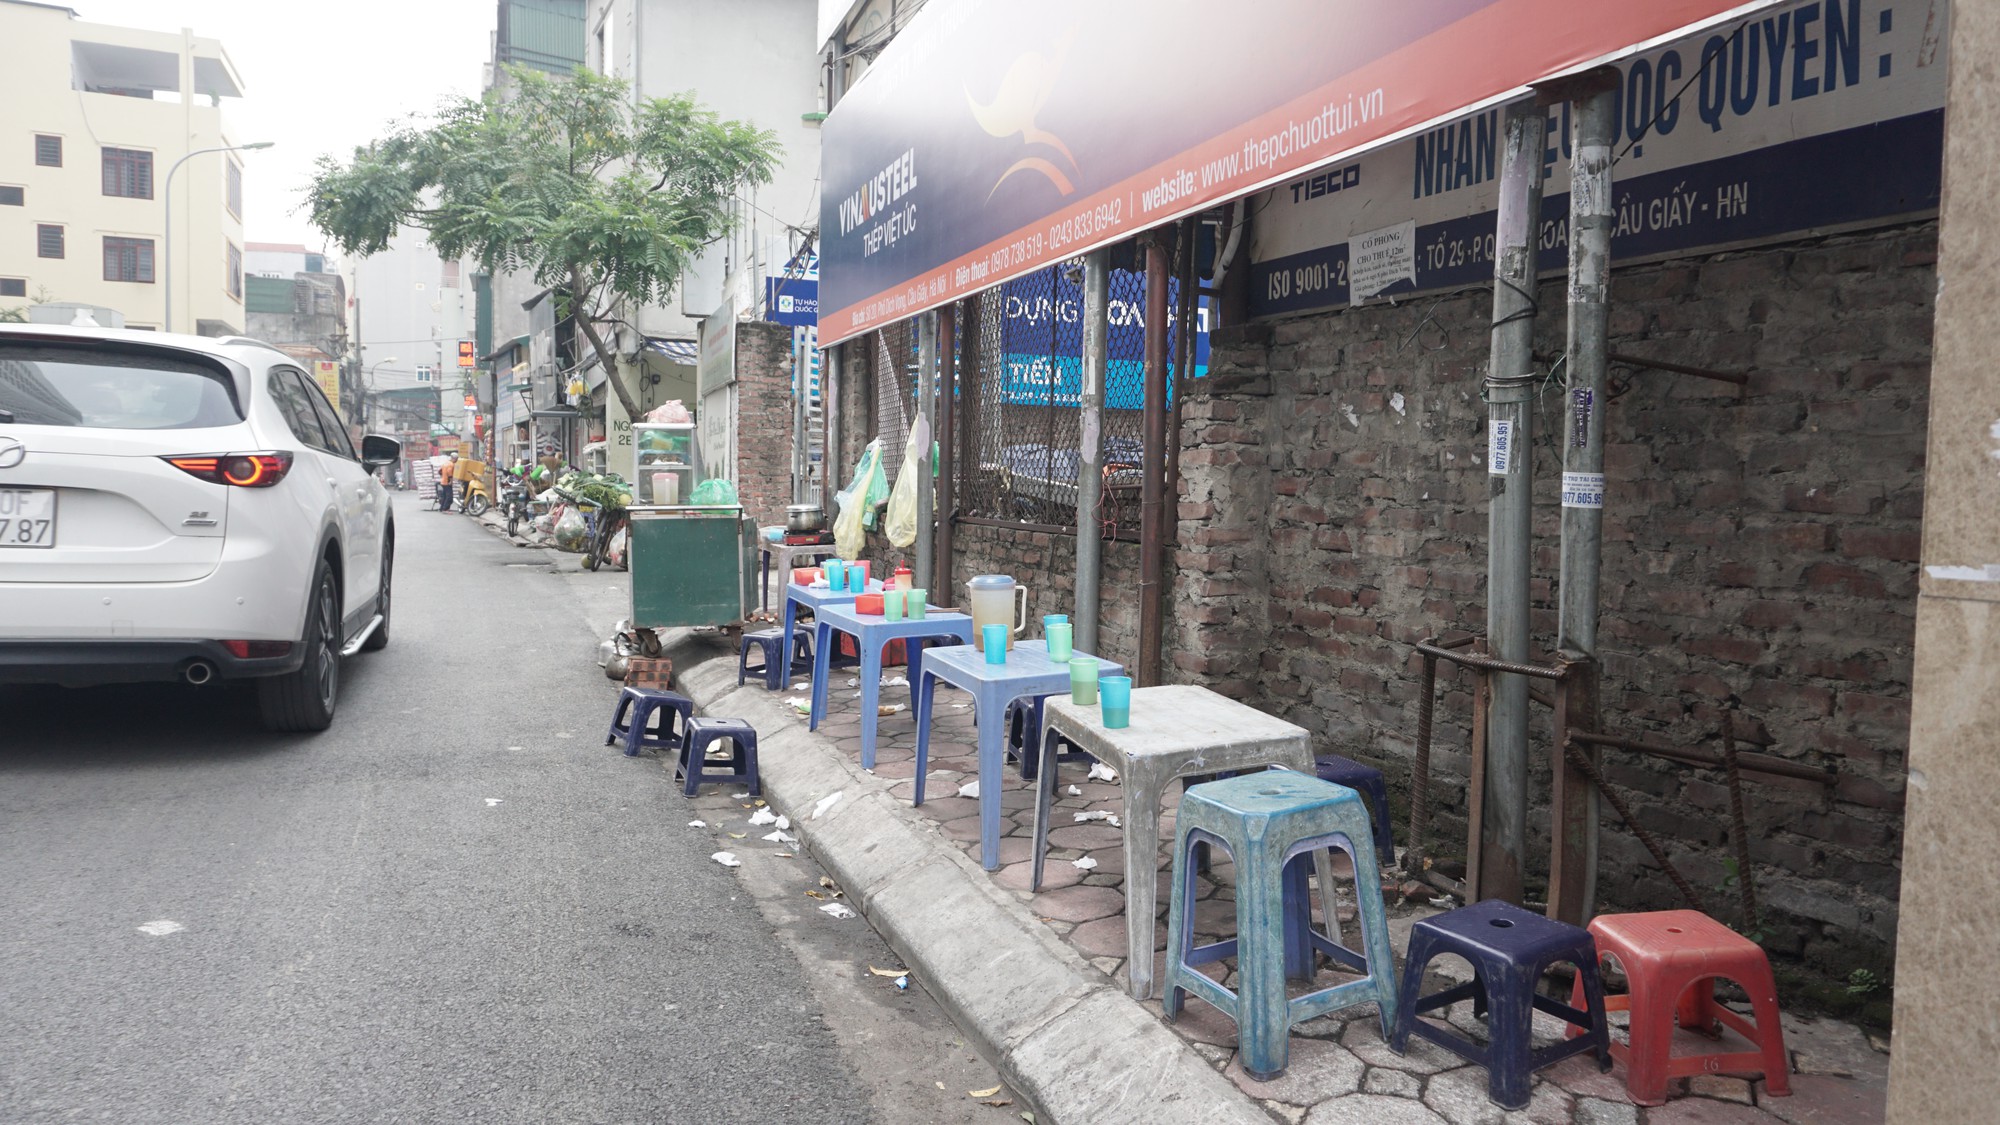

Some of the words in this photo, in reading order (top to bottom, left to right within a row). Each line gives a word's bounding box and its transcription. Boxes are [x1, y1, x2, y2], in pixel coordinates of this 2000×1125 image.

[1142, 168, 1198, 213] website:
[1201, 87, 1384, 202] www.thepchuottui.vn
[1290, 163, 1361, 204] TISCO
[863, 221, 883, 258] THÉP
[882, 211, 902, 248] VIỆT
[902, 201, 917, 236] ÚC
[955, 266, 970, 290] Điện
[971, 256, 989, 281] thoại:
[991, 247, 1009, 273] 0978
[1010, 242, 1026, 268] 738
[1026, 232, 1042, 260] 519
[1049, 220, 1072, 250] 0243
[1074, 210, 1093, 241] 833
[1094, 198, 1122, 232] 6942
[1268, 269, 1290, 301] ISO
[1426, 230, 1447, 271] TỔ
[1539, 219, 1567, 251] OA
[1648, 181, 1698, 231] GIẤY
[1716, 181, 1748, 219] HN
[1356, 255, 1371, 265] CHO
[1495, 422, 1508, 470] 0977.605.951
